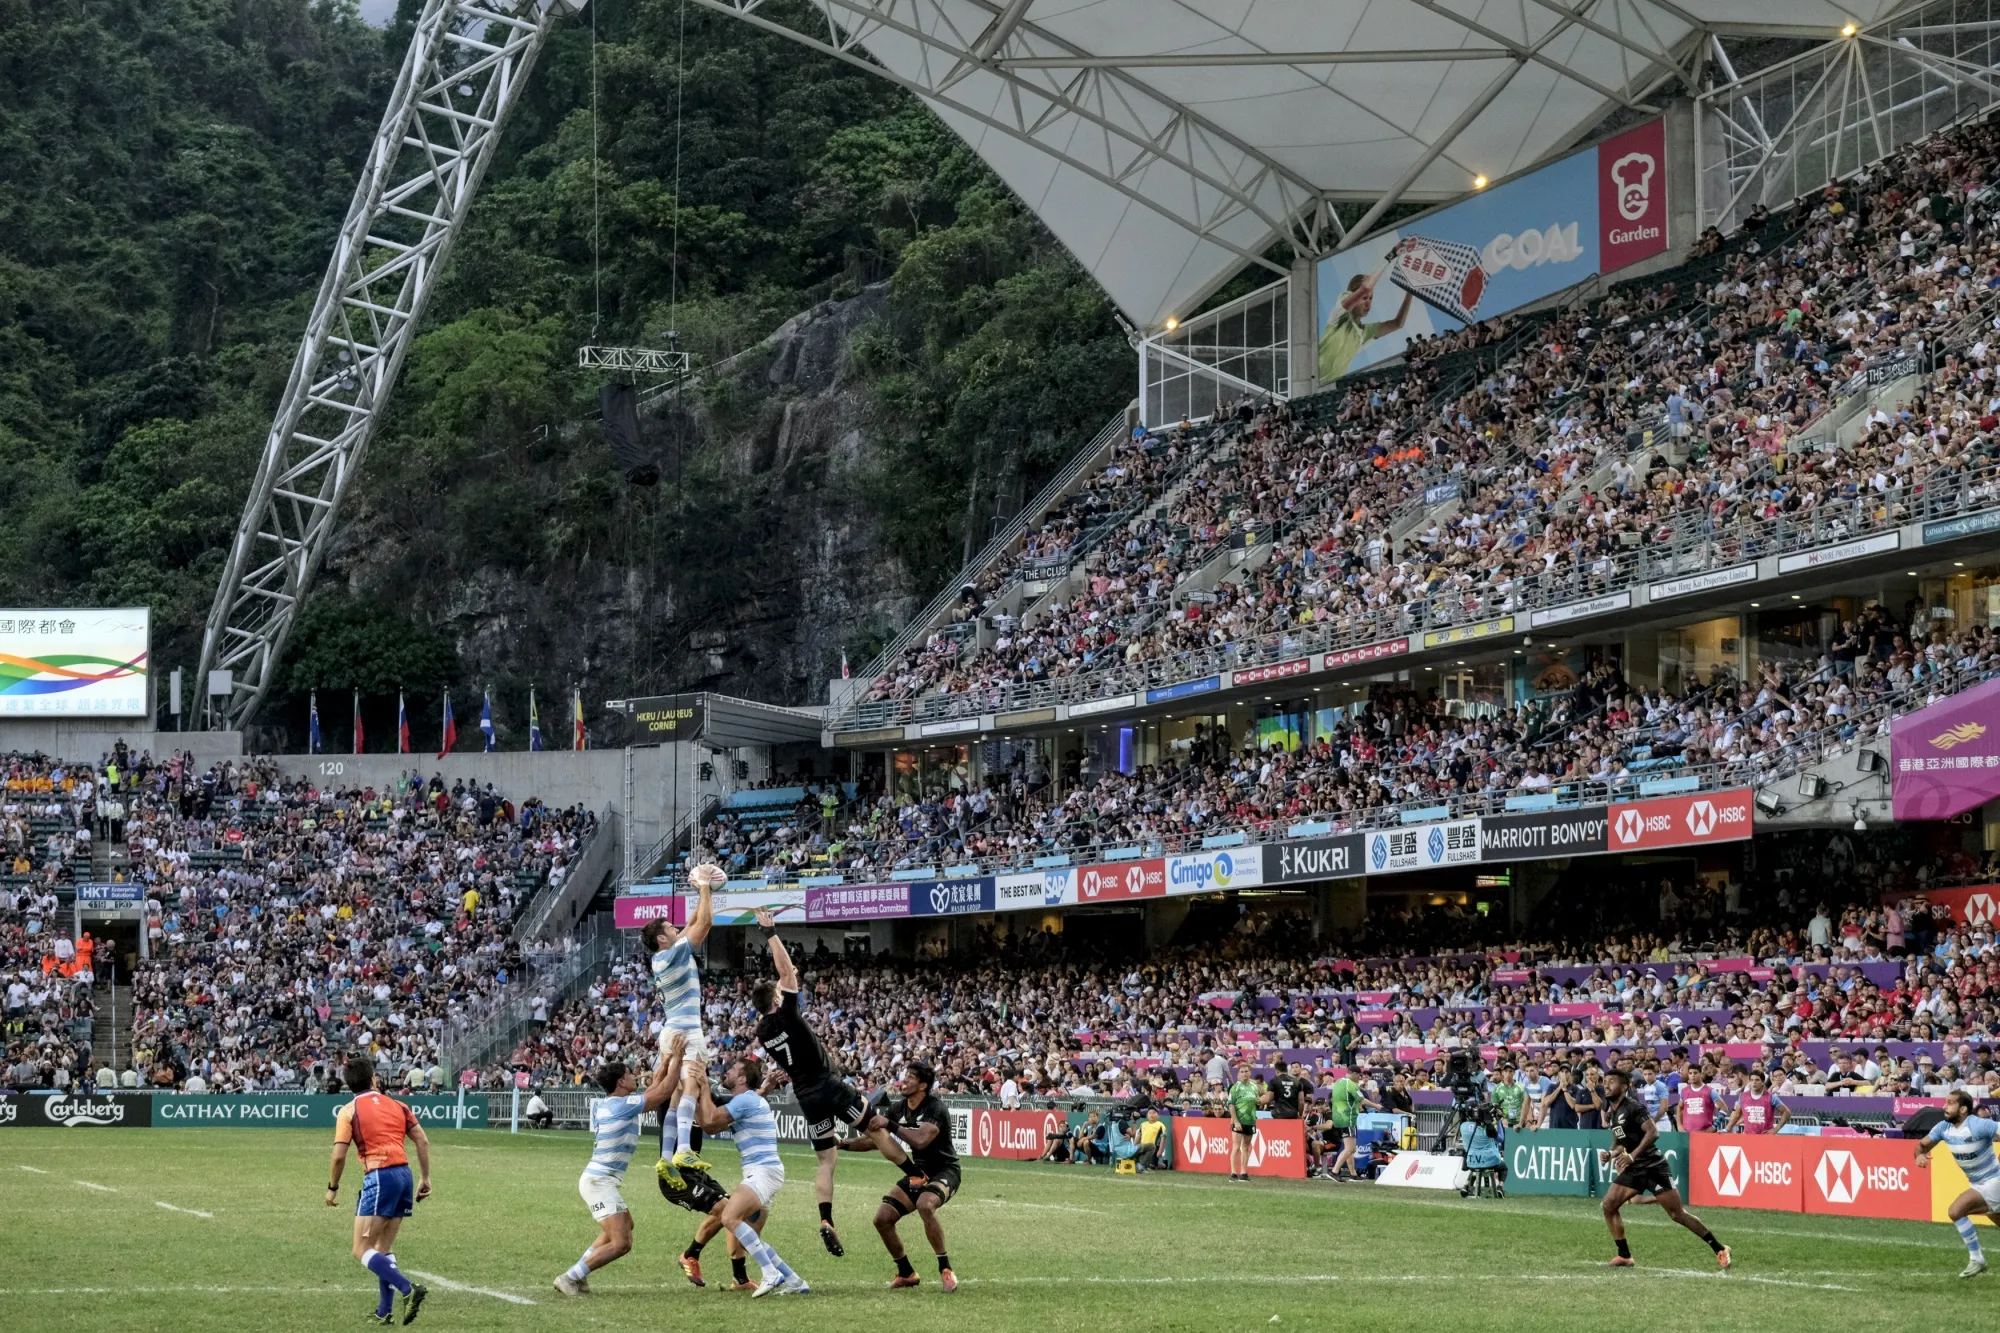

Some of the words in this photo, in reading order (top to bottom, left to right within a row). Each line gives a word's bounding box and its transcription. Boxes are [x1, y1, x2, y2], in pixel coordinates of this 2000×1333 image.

[1609, 225, 1659, 245] Garden
[1485, 221, 1584, 271] GOAL
[1868, 367, 1885, 382] THE
[1426, 487, 1441, 503] HKT
[1835, 544, 1866, 559] PROPERTIES
[1024, 570, 1040, 580] THE
[1046, 565, 1067, 577] CLUB
[1703, 575, 1728, 588] Properties
[1729, 568, 1748, 581] Limited
[1571, 605, 1590, 616] Jardine
[0, 619, 76, 634] 國際都會
[636, 711, 656, 722] HKRU
[662, 708, 693, 720] LAUREUS
[319, 762, 344, 775] 120
[1899, 754, 2000, 771] 香港亞洲國際都
[1646, 814, 1671, 832] HSBC
[1719, 805, 1746, 824] HSBC
[1482, 826, 1547, 850] MARRIOTT
[1551, 818, 1604, 846] BONVOY
[1294, 846, 1350, 874] KUKRI
[1390, 857, 1417, 868] FULLSHARE
[1447, 850, 1477, 862] FULLSHARE
[1102, 876, 1118, 888] HSBC
[1146, 871, 1163, 884] HSBC
[1171, 856, 1213, 889] Cimigo
[83, 887, 110, 898] HKT
[1000, 886, 1012, 898] THE
[1013, 884, 1028, 898] BEST
[1029, 883, 1042, 896] RUN
[1045, 875, 1065, 899] SAP
[633, 904, 668, 919] #HK7S
[825, 906, 841, 917] Major
[841, 905, 859, 916] Sports
[860, 904, 878, 914] Events
[879, 903, 908, 914] Committee
[1931, 904, 1951, 920] SBC
[775, 1042, 793, 1065] 7
[1284, 1086, 1291, 1098] 3
[44, 1095, 125, 1127] Carlsberg
[160, 1104, 236, 1118] CATHAY
[240, 1104, 309, 1118] PACIFIC
[640, 1110, 659, 1128] MARRI
[773, 1109, 808, 1139] KUKRI
[817, 1120, 831, 1133] AIG
[999, 1120, 1037, 1150] UL.com
[1208, 1137, 1229, 1155] HSBC
[1268, 1140, 1292, 1158] HSBC
[1468, 1154, 1485, 1164] T.V.
[1513, 1144, 1592, 1182] CATHAY
[1754, 1161, 1792, 1186] HSBC
[1867, 1165, 1909, 1191] HSBC
